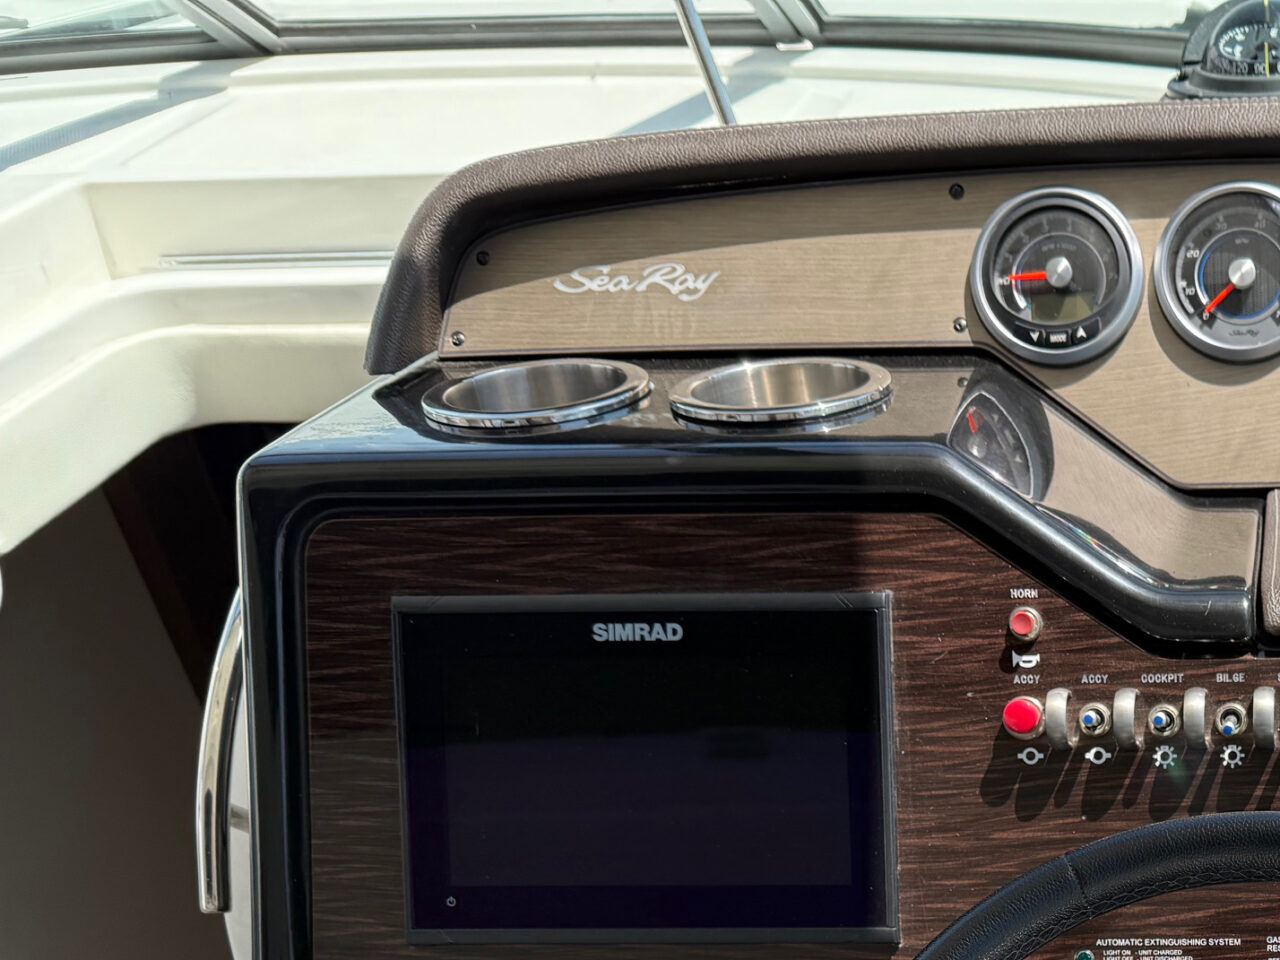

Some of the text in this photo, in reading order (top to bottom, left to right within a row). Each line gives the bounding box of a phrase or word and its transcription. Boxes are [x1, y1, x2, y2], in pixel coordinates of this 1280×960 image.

[1187, 250, 1199, 258] 20
[553, 263, 721, 301] Sea Ray
[1185, 287, 1195, 296] 10
[1050, 333, 1067, 343] MODE
[1010, 588, 1038, 598] HORN
[592, 623, 683, 641] SIMRAD
[1013, 674, 1040, 684] ACCY
[1081, 674, 1108, 684] ACCY
[1141, 673, 1184, 683] COCKPIT
[1216, 672, 1245, 683] BILGE
[1096, 938, 1241, 946] AUTOMATIC EXTINGUISHING SYSTEM
